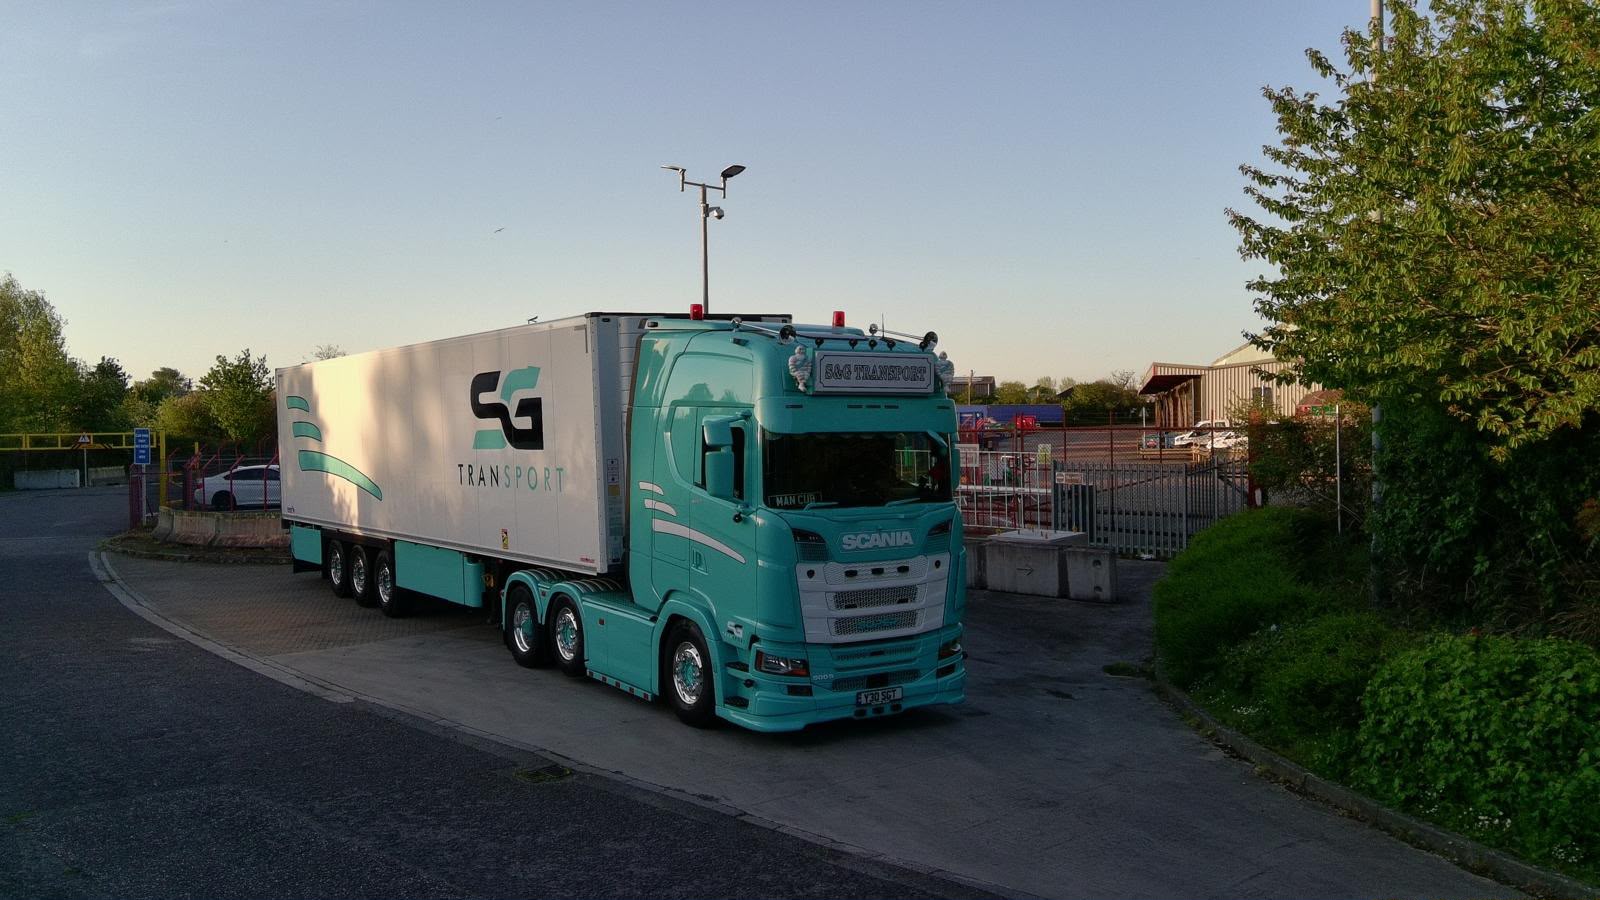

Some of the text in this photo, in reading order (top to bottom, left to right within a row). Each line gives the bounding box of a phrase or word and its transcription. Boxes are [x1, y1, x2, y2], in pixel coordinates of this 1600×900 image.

[824, 363, 926, 381] S&G TRANSPORT
[457, 463, 564, 492] TRANSPORT
[776, 495, 796, 507] MAN
[842, 531, 914, 550] SCANIA
[881, 689, 897, 700] SGT
